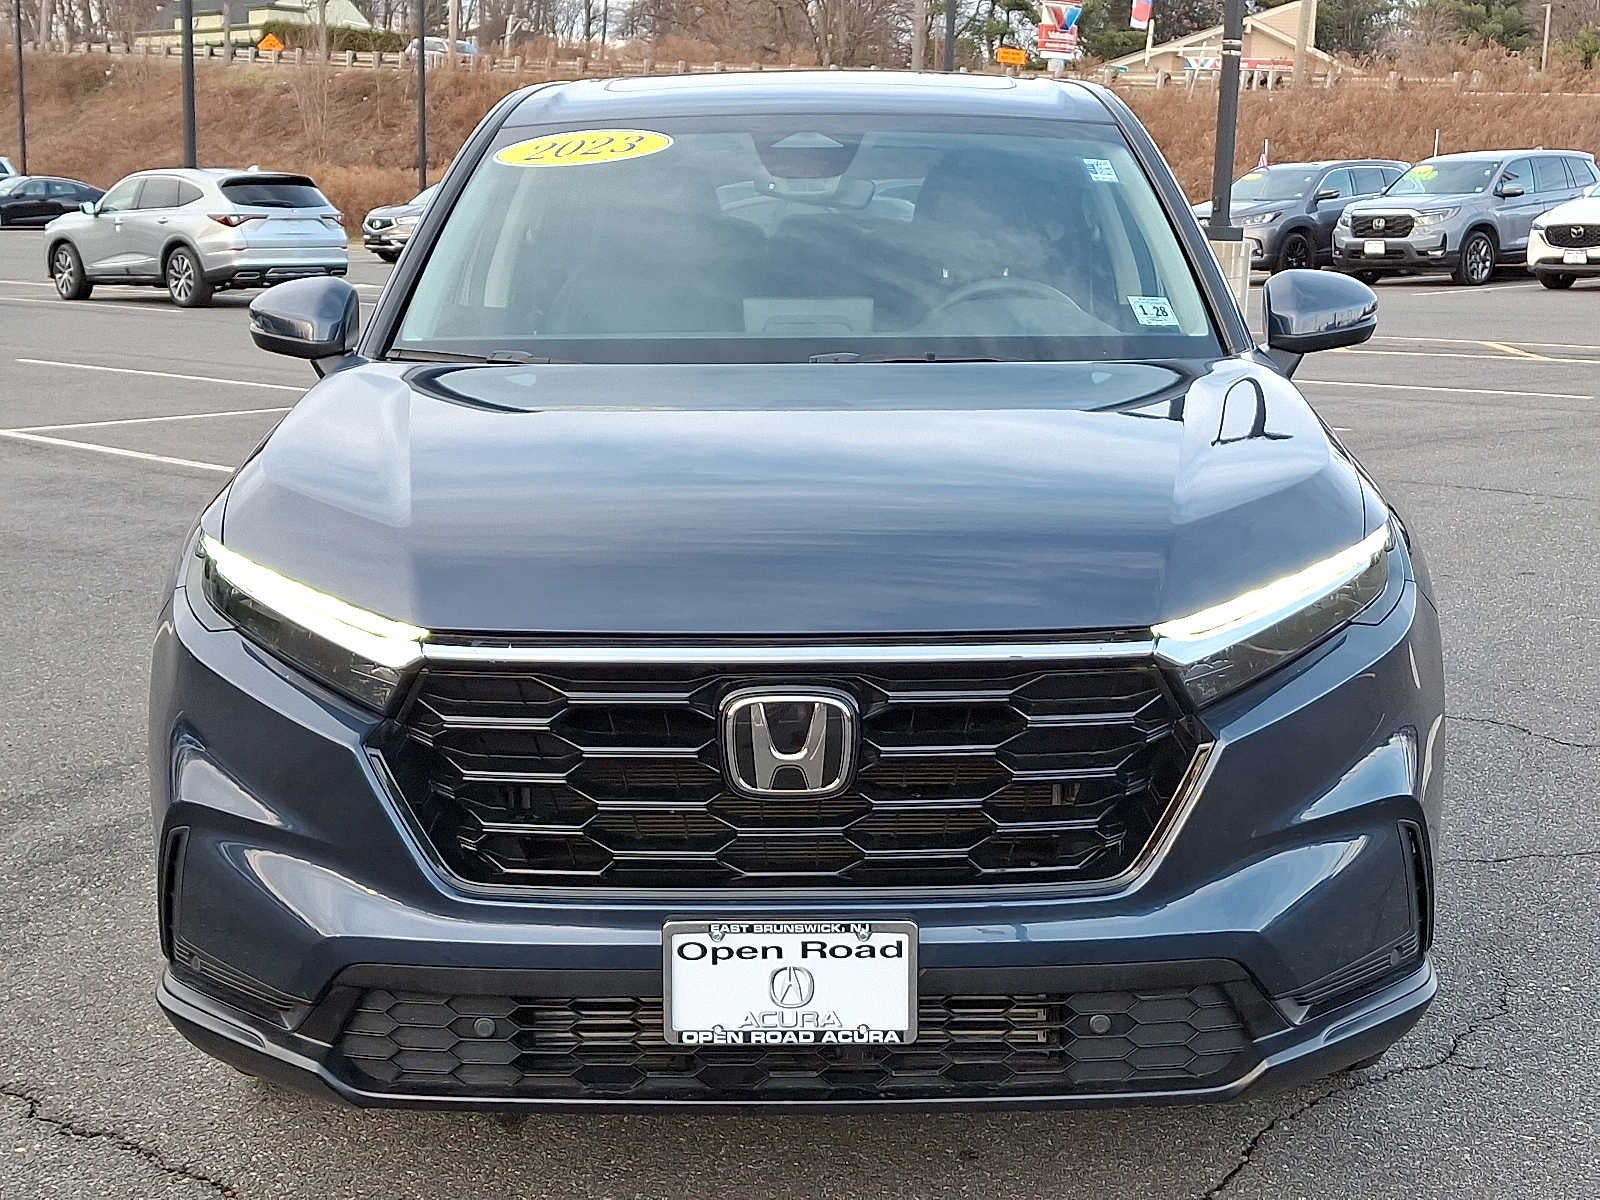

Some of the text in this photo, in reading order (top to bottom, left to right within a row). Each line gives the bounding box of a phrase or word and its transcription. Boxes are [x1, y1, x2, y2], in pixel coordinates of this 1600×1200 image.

[523, 135, 645, 161] 2023
[1153, 306, 1168, 316] 28
[709, 923, 750, 934] EAST
[676, 940, 904, 966] Open Road
[738, 1010, 843, 1029] ACURA
[681, 1030, 901, 1044] OPEN ROAD ACURA
